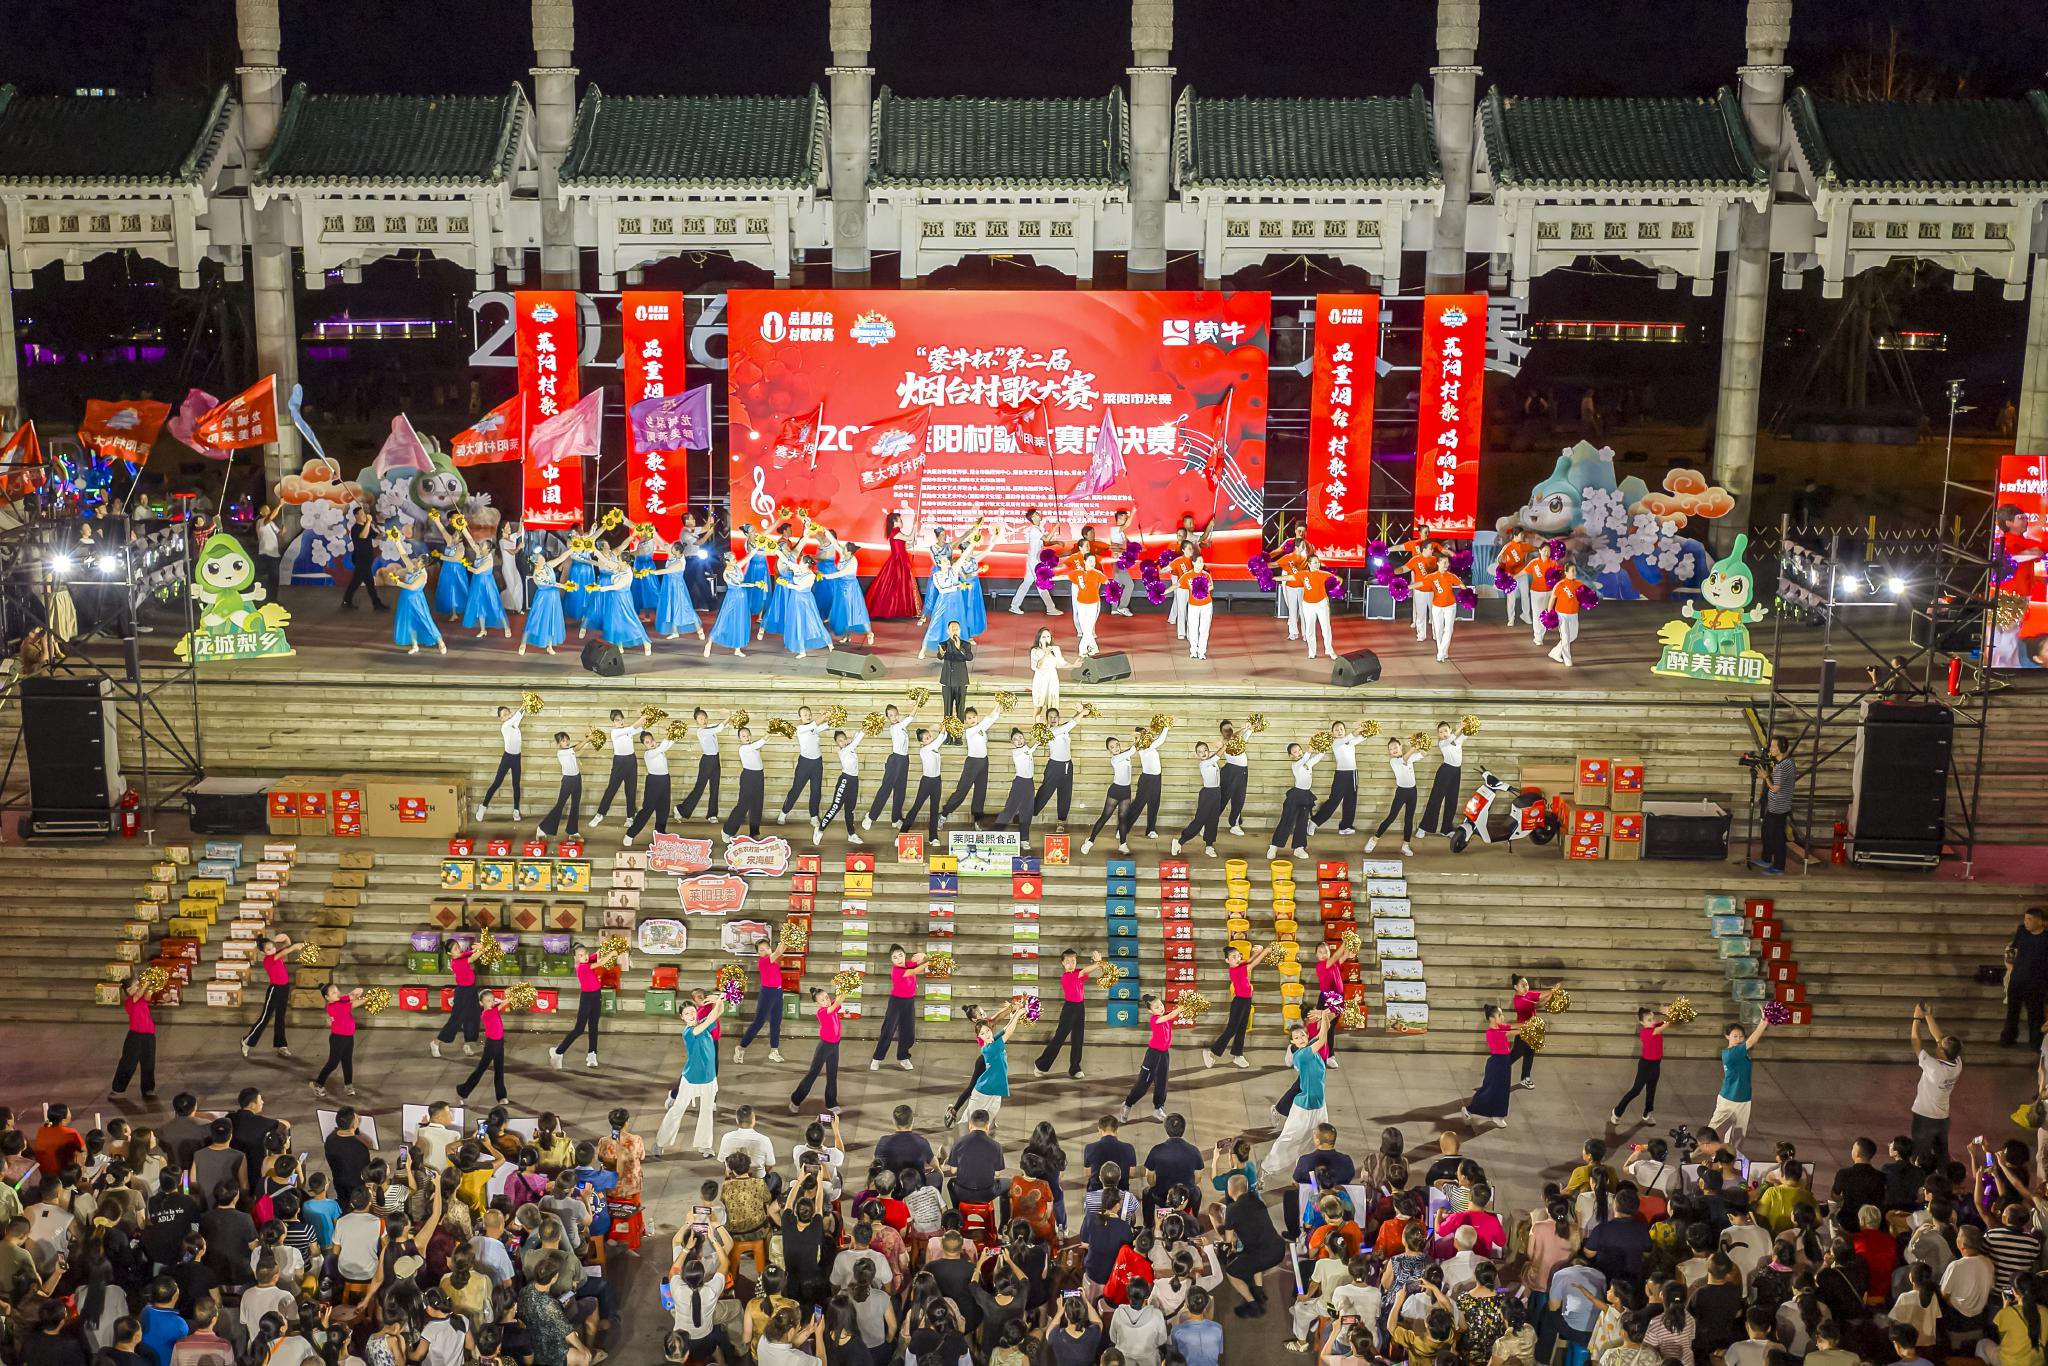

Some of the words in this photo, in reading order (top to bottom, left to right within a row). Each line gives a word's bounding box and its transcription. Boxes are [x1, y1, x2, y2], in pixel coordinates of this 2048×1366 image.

[1194, 320, 1246, 345] 蒙牛
[916, 346, 1072, 374] “蒙牛杯”第二届
[896, 370, 1100, 411] 烟台村歌大赛
[1103, 392, 1172, 405] 莱阳市决赛
[536, 332, 563, 504] 莱阳村歌中国
[642, 339, 667, 515] 品重烟歌嘹亮
[194, 631, 280, 655] 龙城梨乡
[1666, 650, 1764, 679] 醉美莱阳
[389, 804, 436, 812] SKTH
[953, 834, 1017, 845] 莱阳晨熙食品
[689, 888, 737, 902] 莱阳县委
